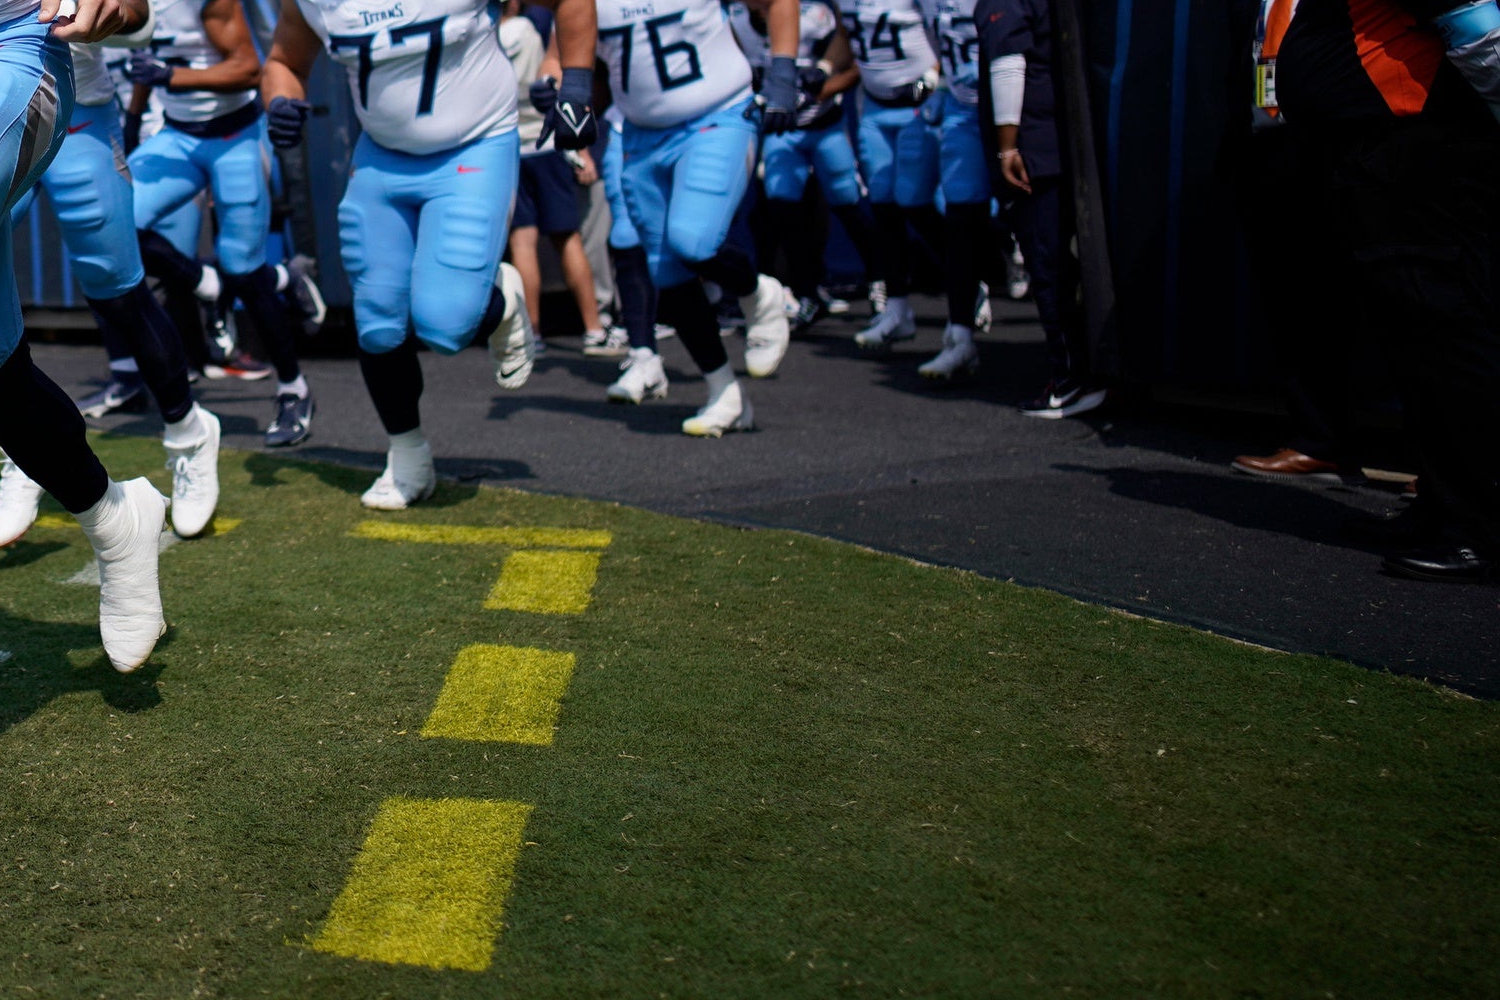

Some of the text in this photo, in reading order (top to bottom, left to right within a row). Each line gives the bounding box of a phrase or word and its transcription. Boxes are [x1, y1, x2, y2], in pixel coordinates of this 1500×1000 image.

[358, 2, 404, 26] TITANS
[597, 9, 704, 94] 76
[329, 15, 451, 118] 77
